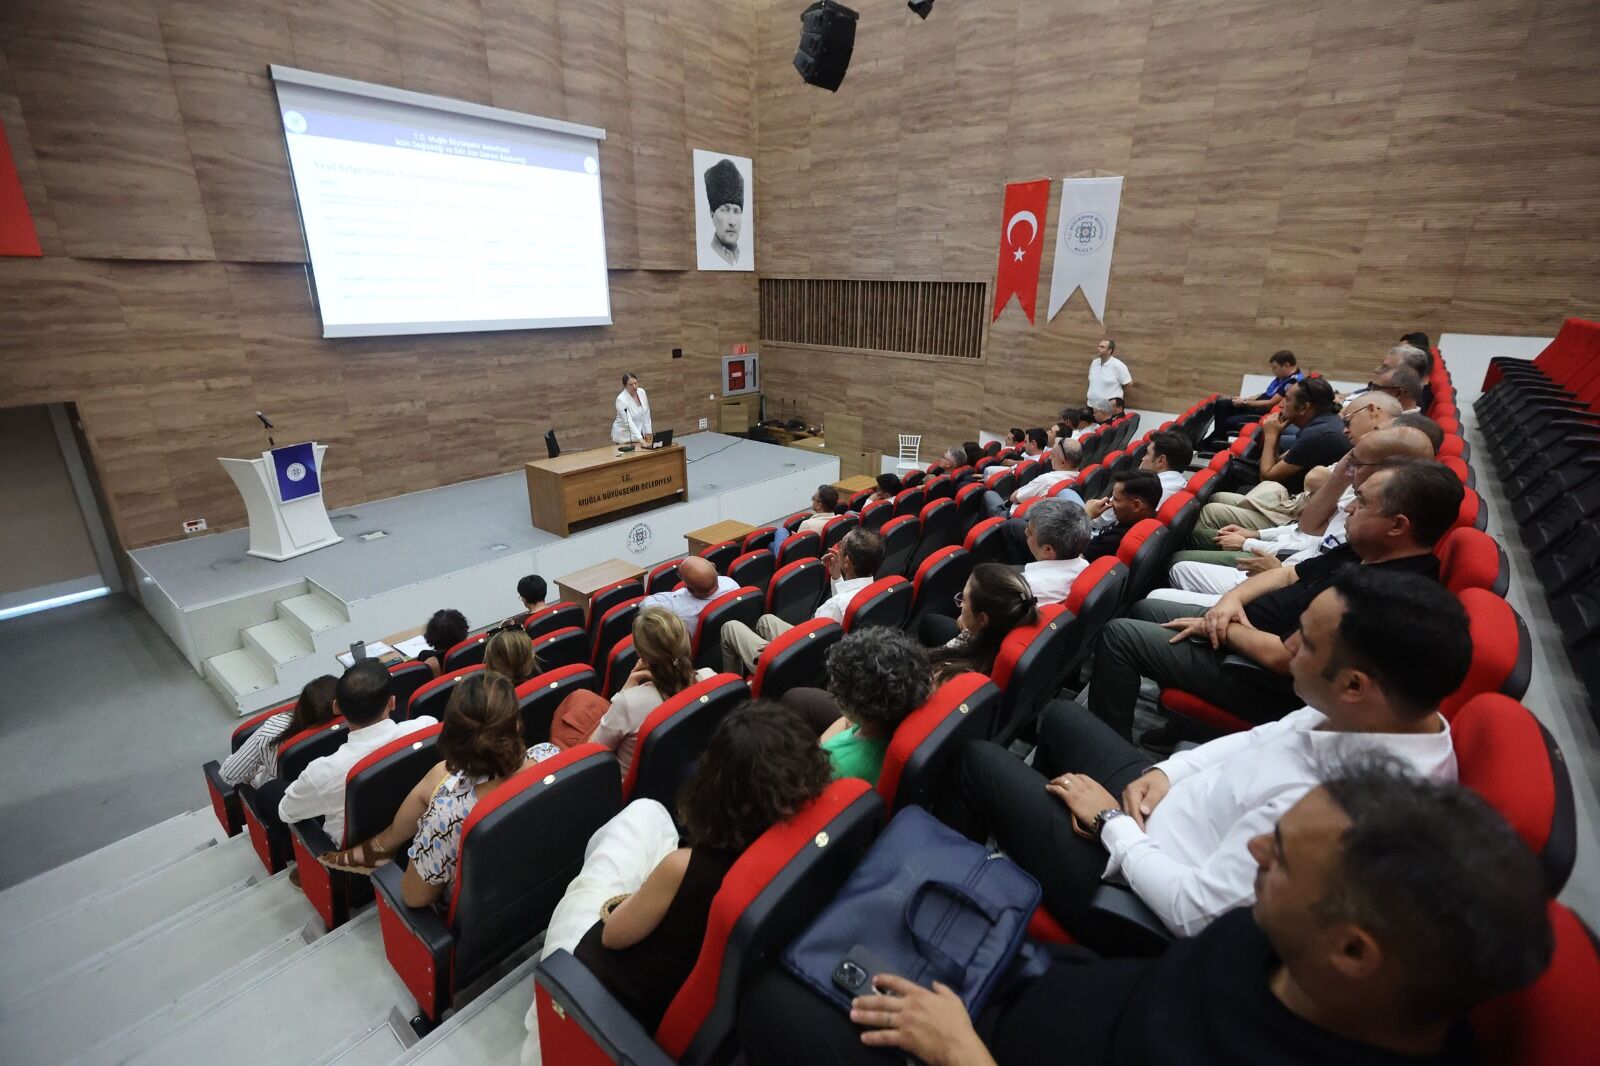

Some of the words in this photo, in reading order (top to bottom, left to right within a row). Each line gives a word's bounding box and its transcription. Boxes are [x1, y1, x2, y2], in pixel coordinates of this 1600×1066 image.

[621, 473, 632, 483] T.C.
[578, 494, 601, 507] MUĞLA
[602, 484, 640, 500] BÜYÜKŞEHİR
[641, 475, 672, 490] BELEDİYESİ
